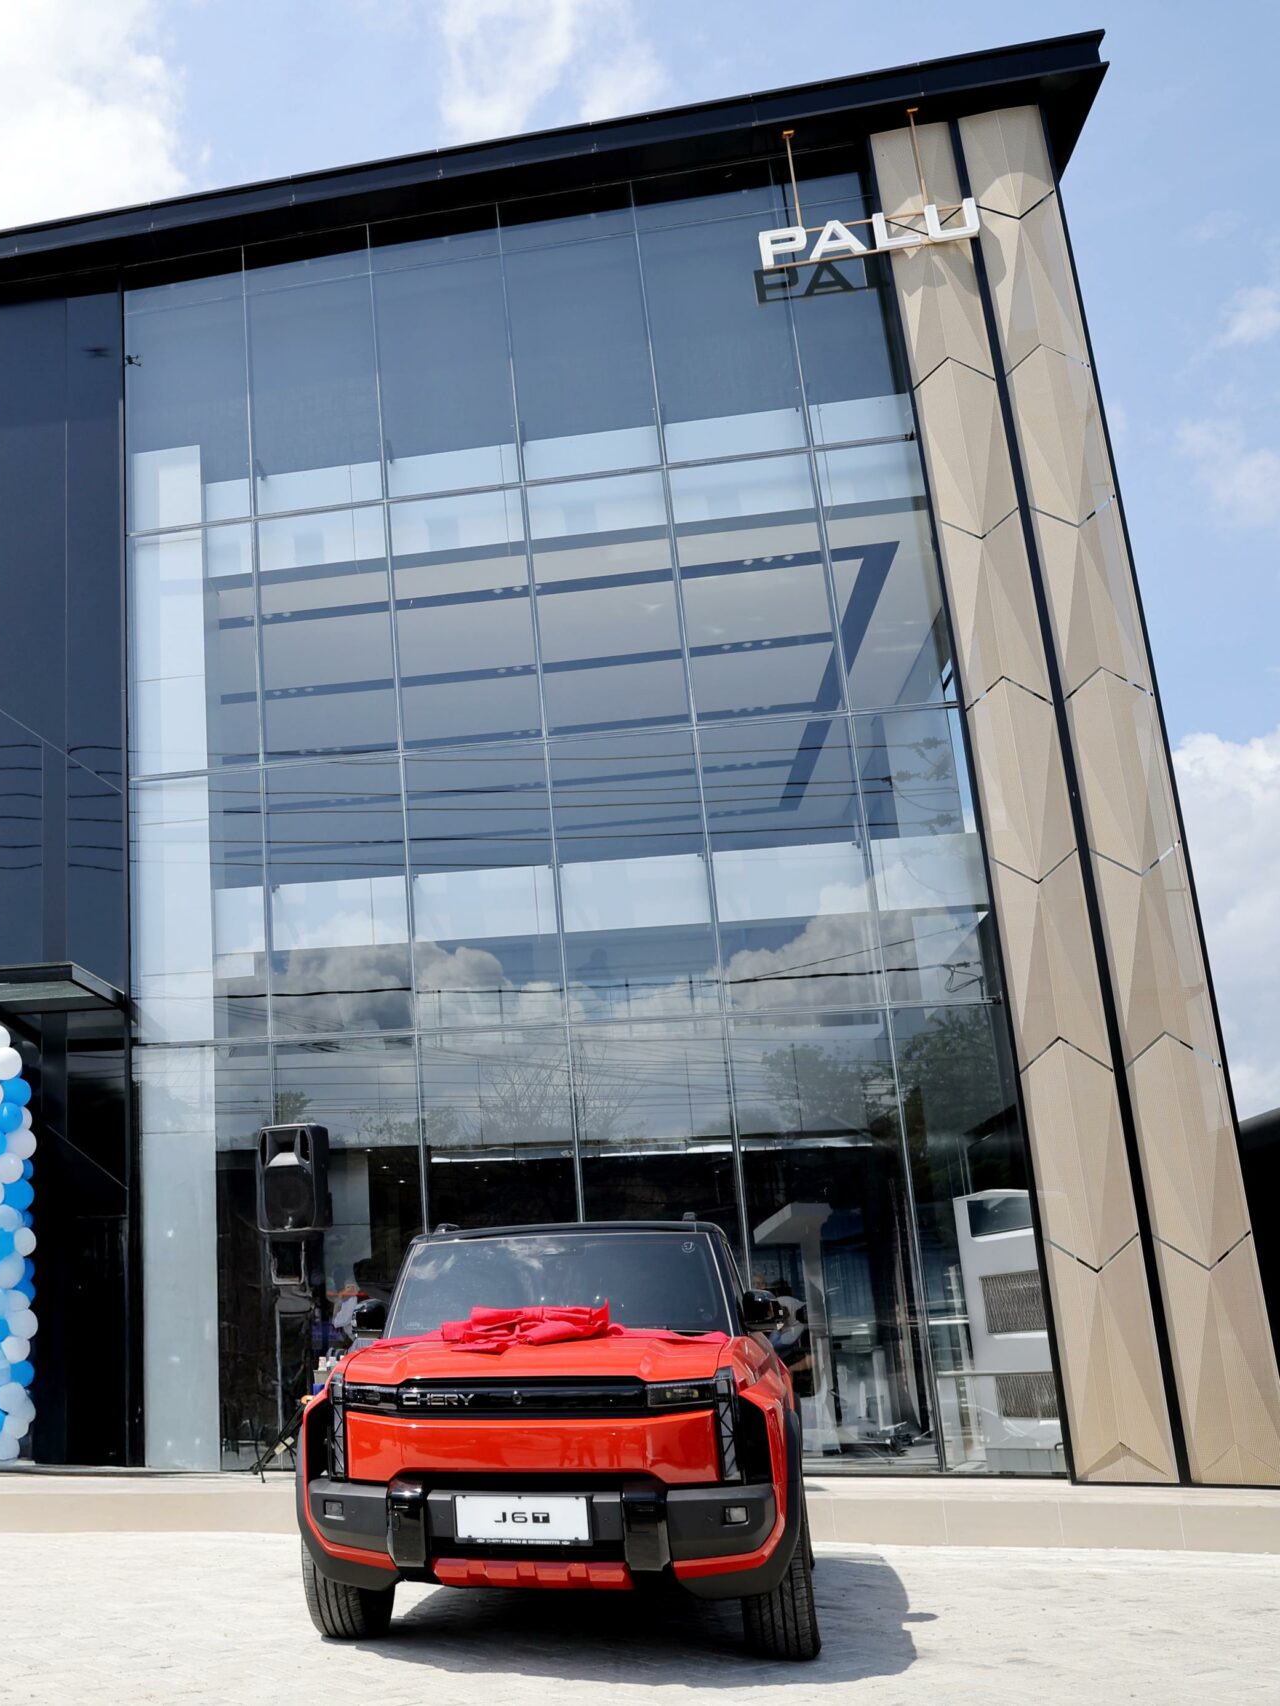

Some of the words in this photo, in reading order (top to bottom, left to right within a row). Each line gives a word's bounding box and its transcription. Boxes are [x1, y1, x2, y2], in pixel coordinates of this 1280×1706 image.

[758, 197, 981, 270] PALU
[402, 1393, 475, 1406] CHERY
[493, 1511, 551, 1524] J6T
